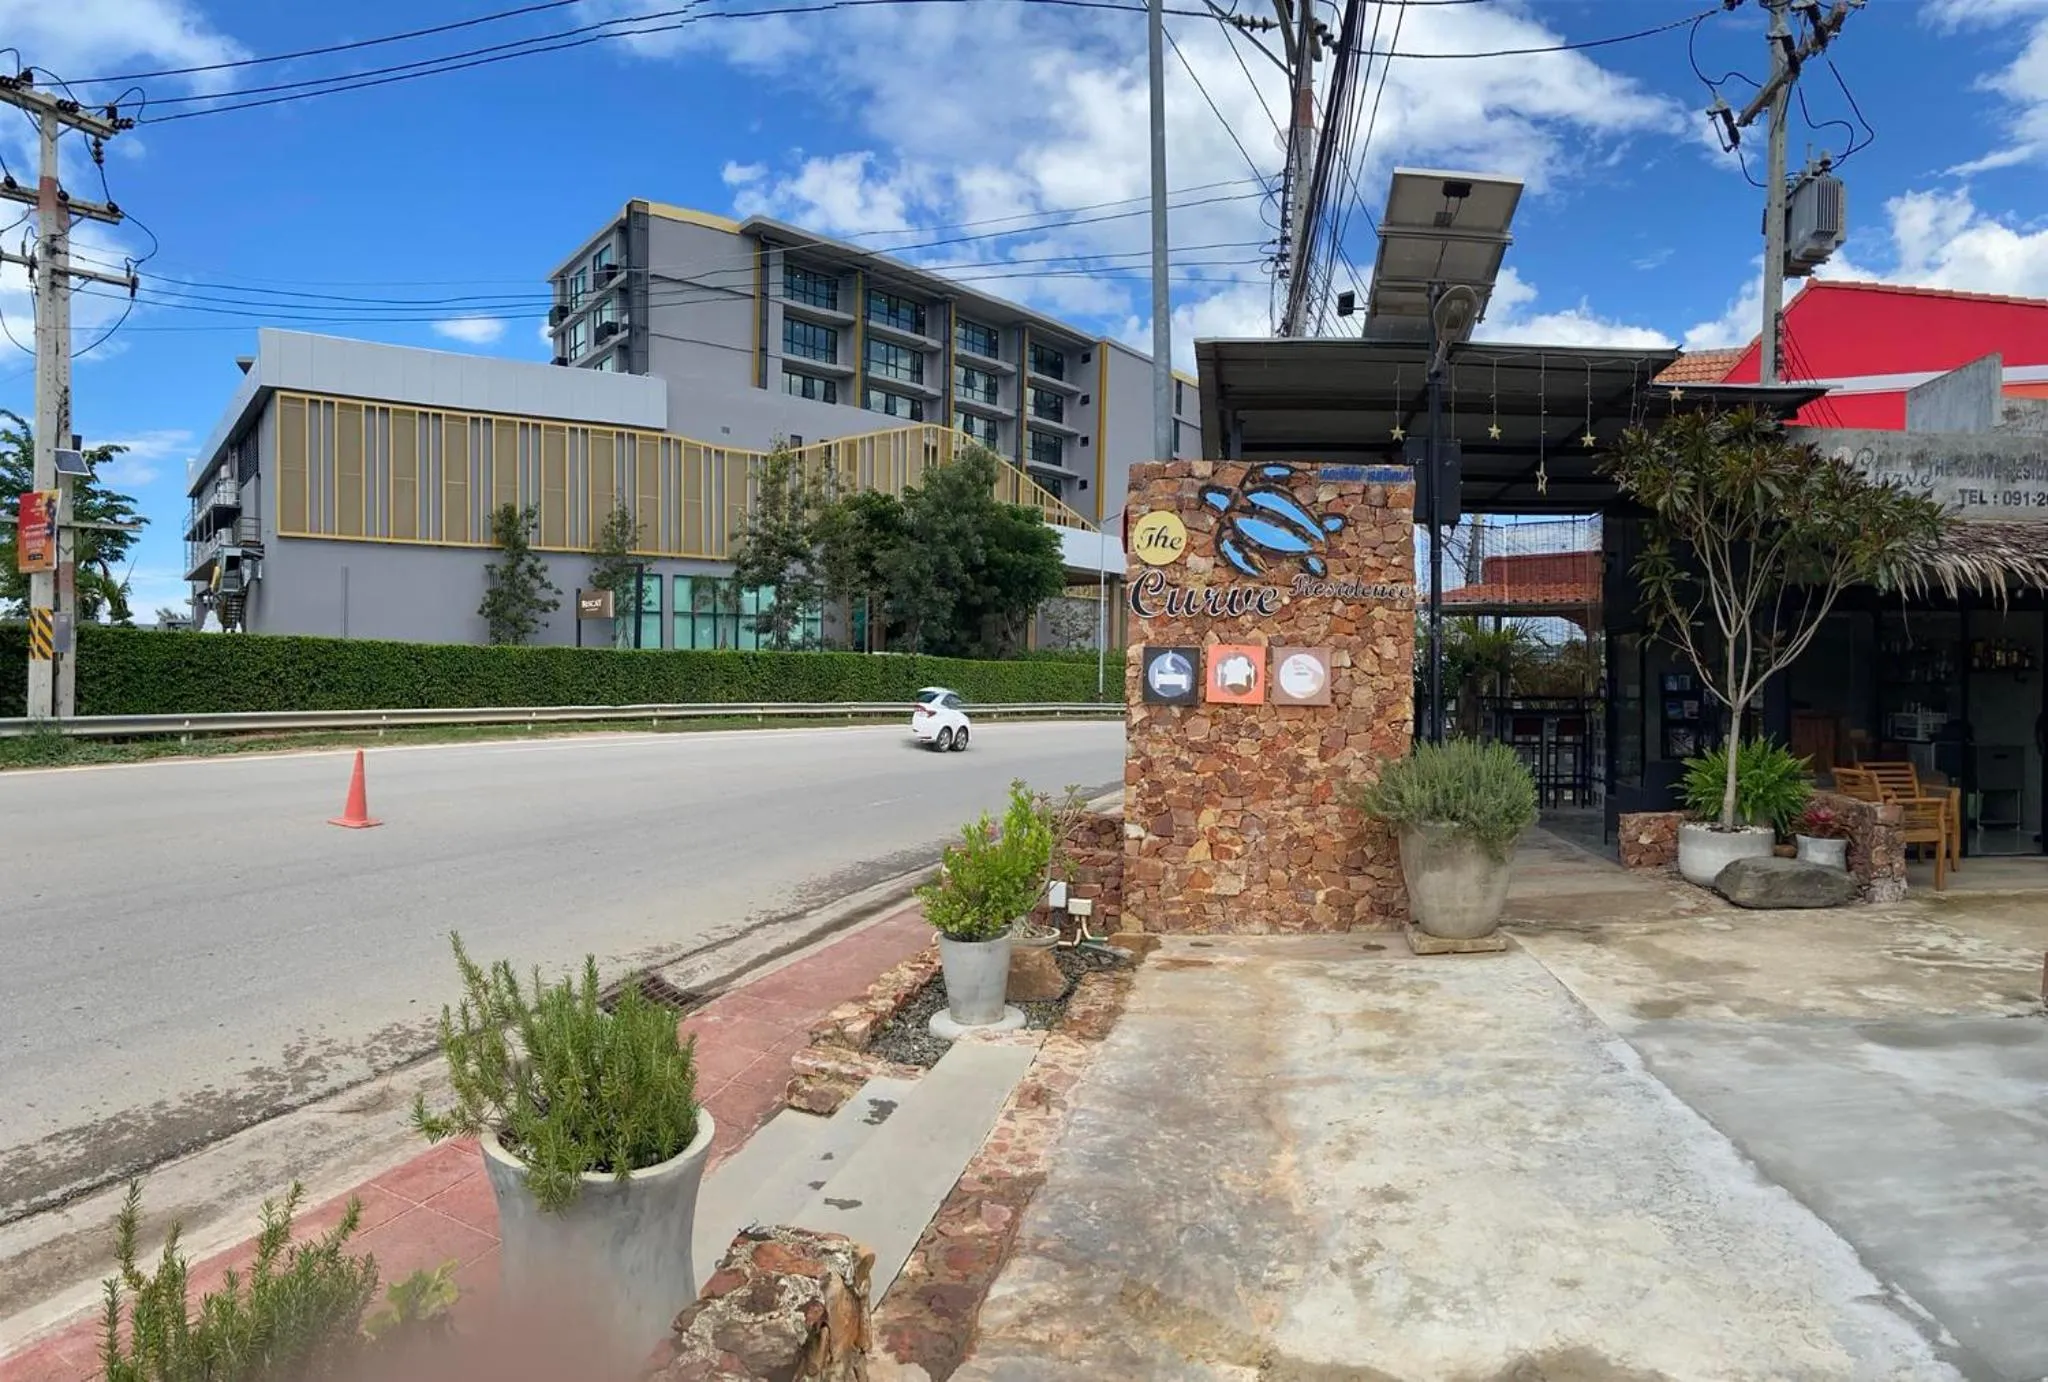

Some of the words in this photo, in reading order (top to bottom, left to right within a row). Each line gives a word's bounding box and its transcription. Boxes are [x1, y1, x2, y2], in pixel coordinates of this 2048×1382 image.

[1958, 488, 1988, 505] TEL
[2002, 490, 2048, 507] 091-2
[1136, 525, 1182, 550] The
[1130, 569, 1280, 618] Curve
[1288, 573, 1412, 600] Residence
